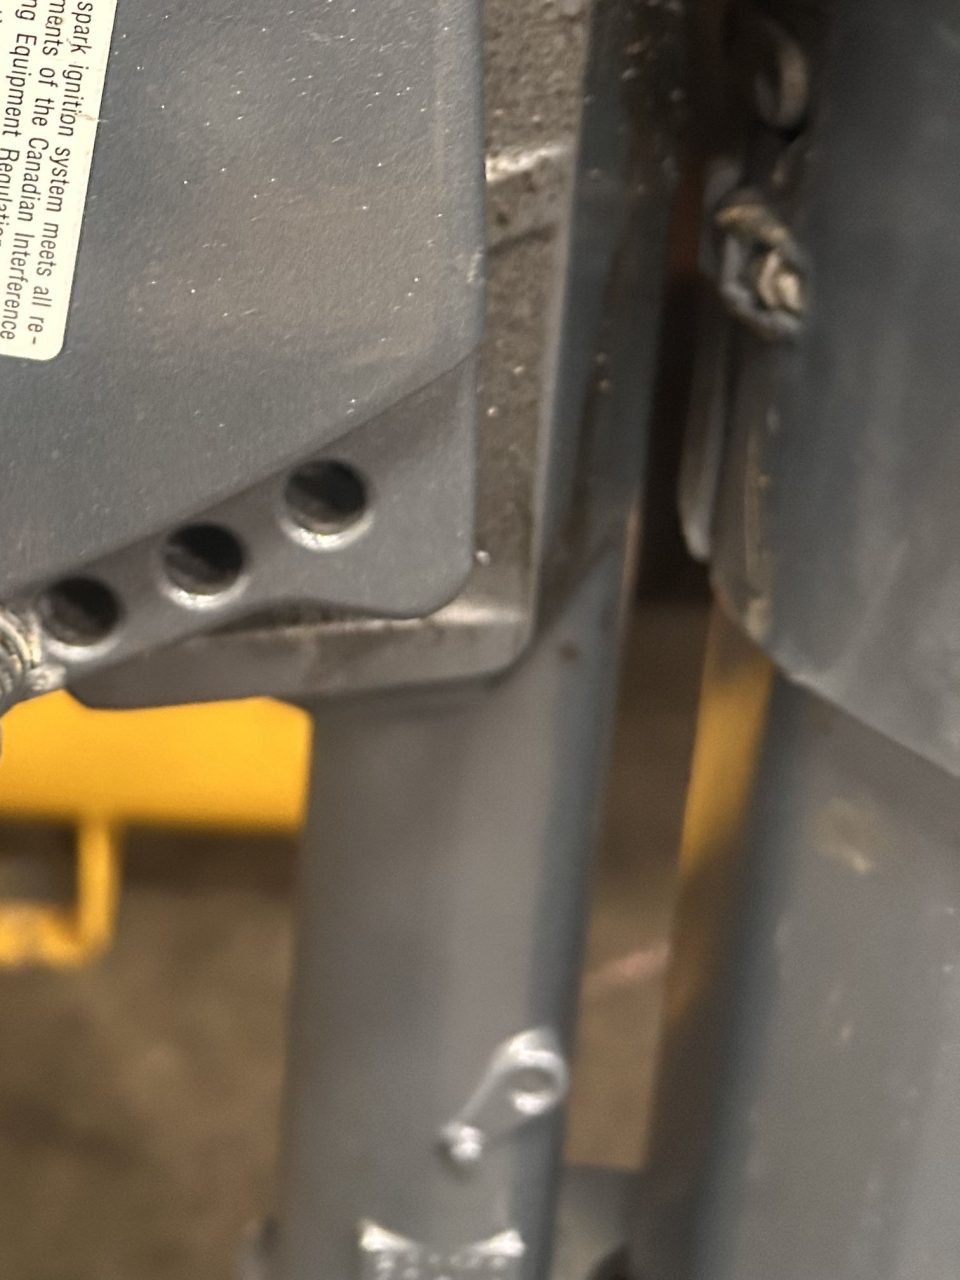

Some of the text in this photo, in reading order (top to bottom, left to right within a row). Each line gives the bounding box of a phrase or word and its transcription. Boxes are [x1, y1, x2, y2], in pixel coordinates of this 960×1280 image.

[70, 1, 94, 55] spark
[2, 33, 38, 137] Equipment
[37, 67, 58, 88] of
[57, 64, 90, 137] ignition
[31, 97, 55, 127] the
[17, 137, 50, 222] Canadian
[46, 146, 71, 213] system
[35, 222, 59, 277] meets
[0, 232, 36, 340] Interference
[31, 285, 53, 308] all
